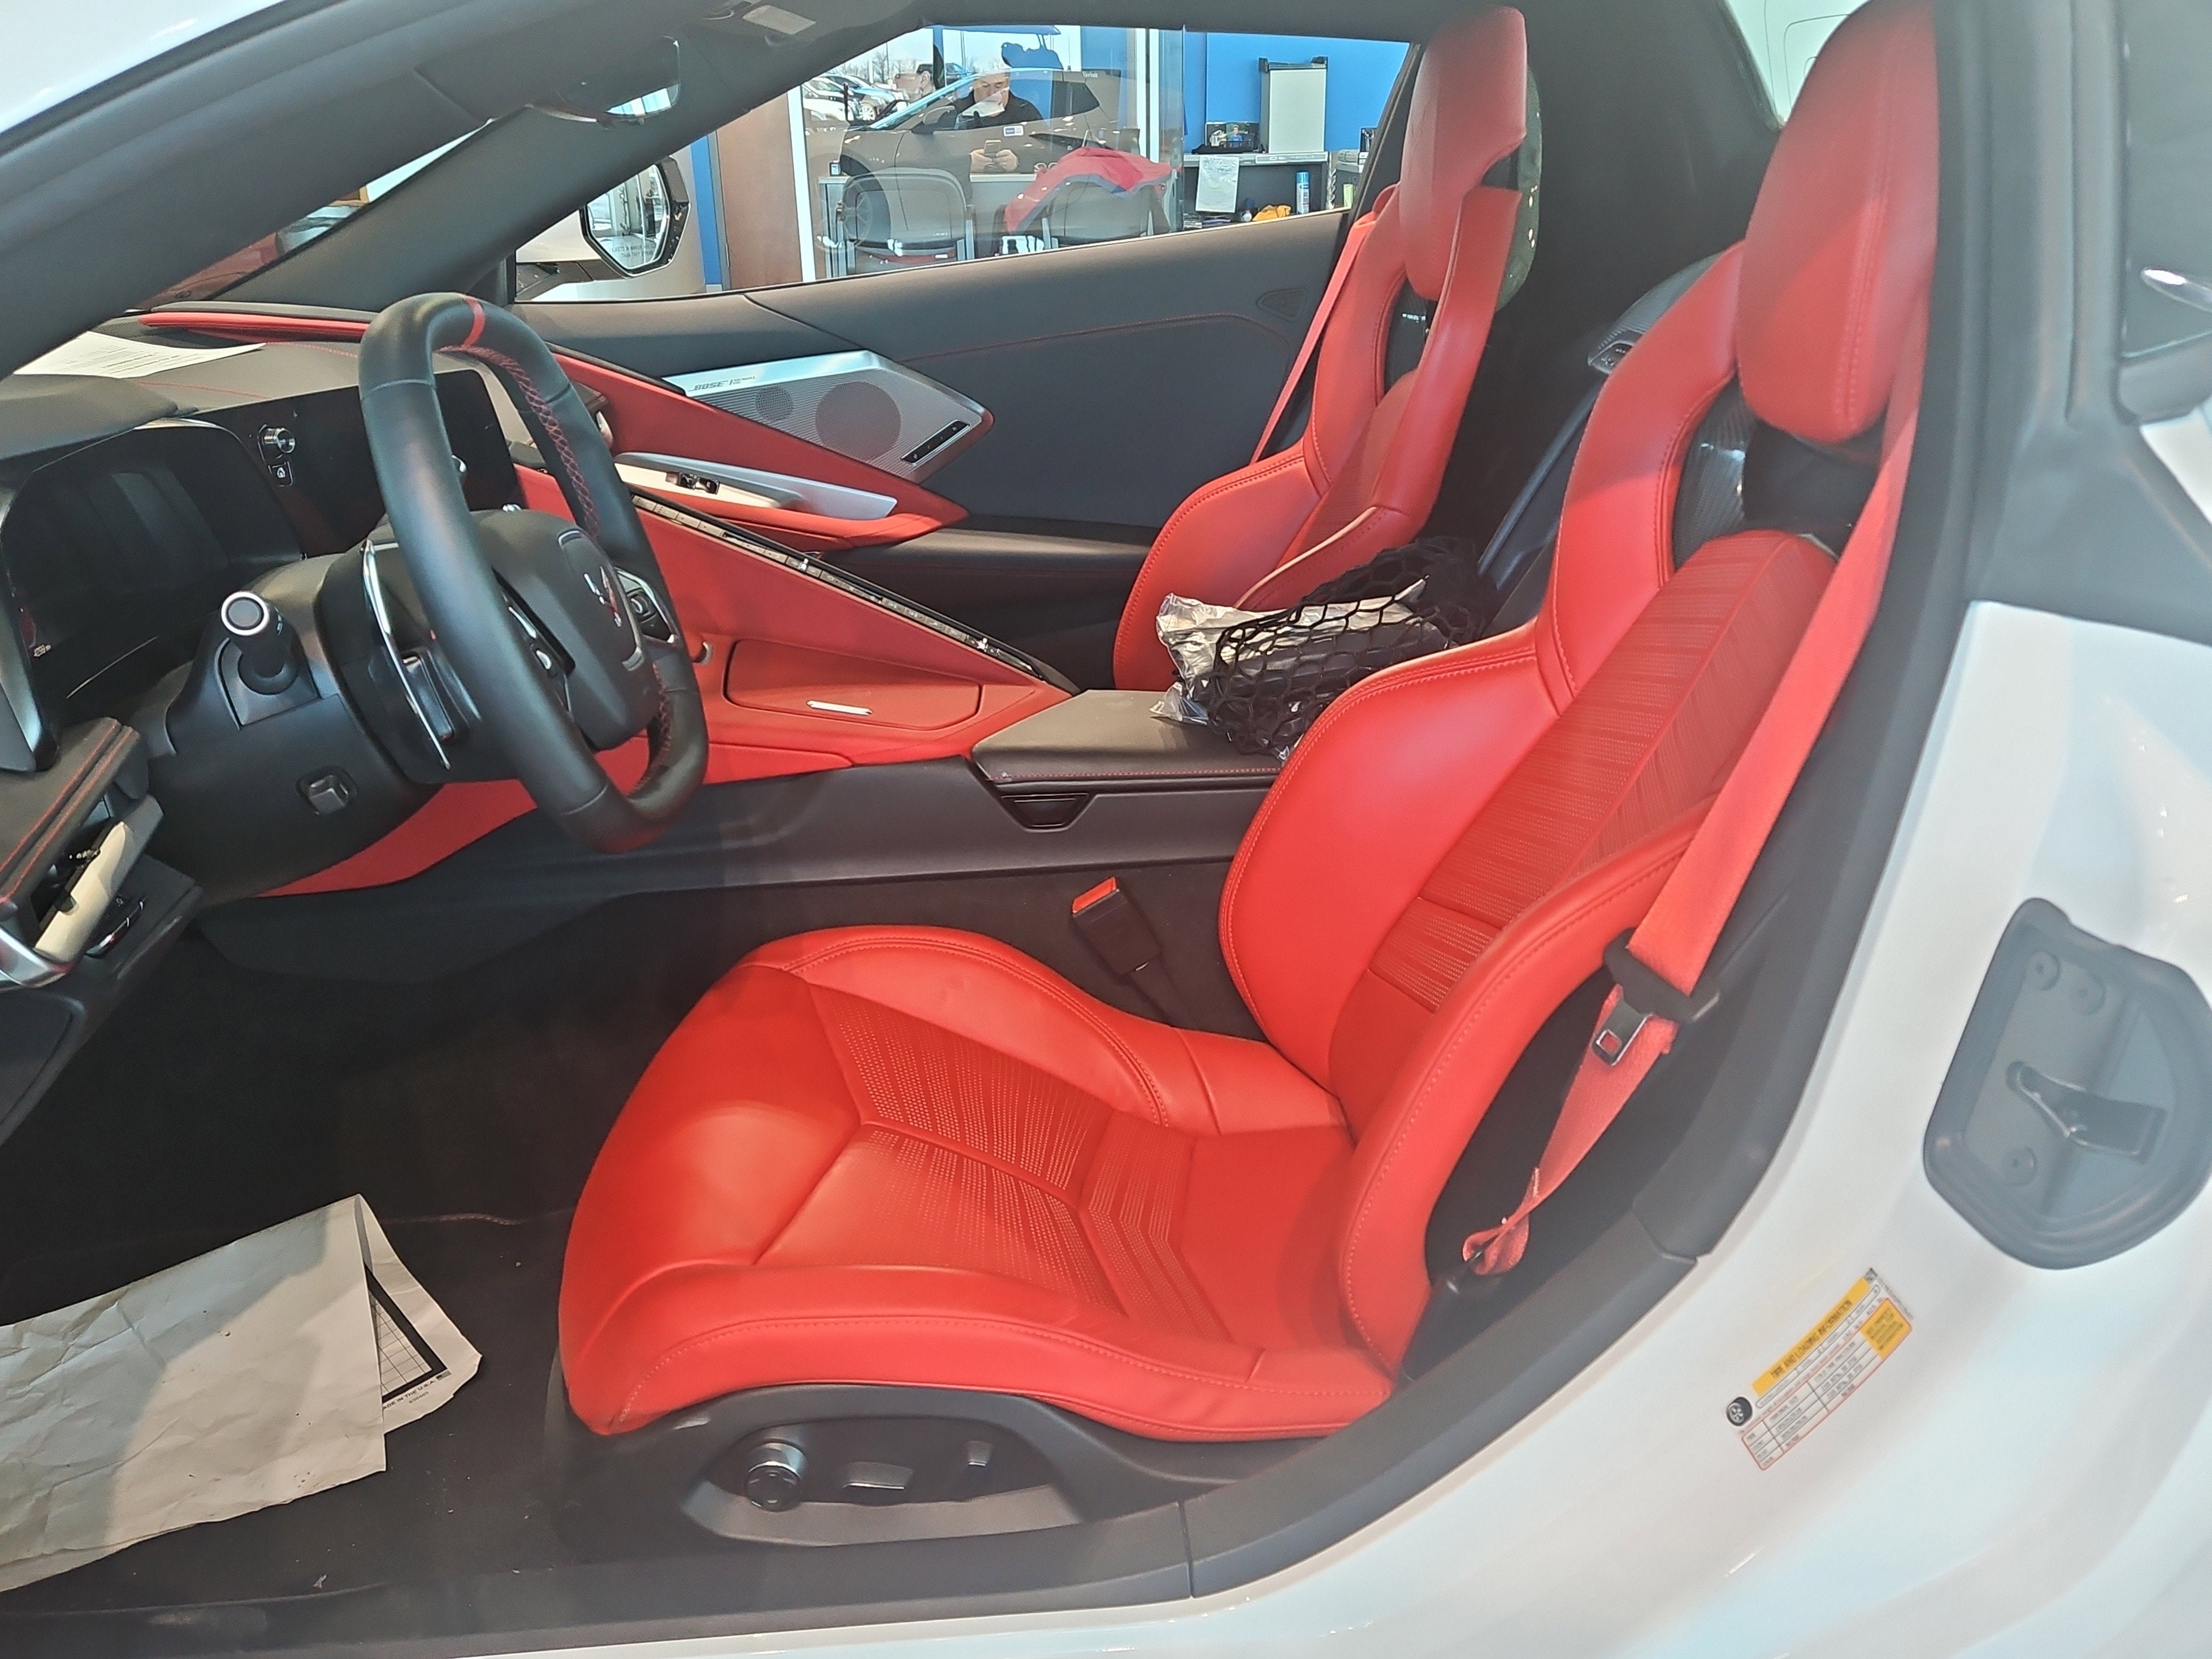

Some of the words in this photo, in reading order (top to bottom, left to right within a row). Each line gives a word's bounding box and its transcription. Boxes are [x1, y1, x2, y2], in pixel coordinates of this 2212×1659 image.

[689, 381, 728, 391] BOSE
[1781, 1353, 1798, 1370] AND
[1792, 1331, 1821, 1359] LOADING
[1816, 1298, 1853, 1336] INFORMATION
[382, 1400, 396, 1410] ADE
[404, 1388, 417, 1398] THE
